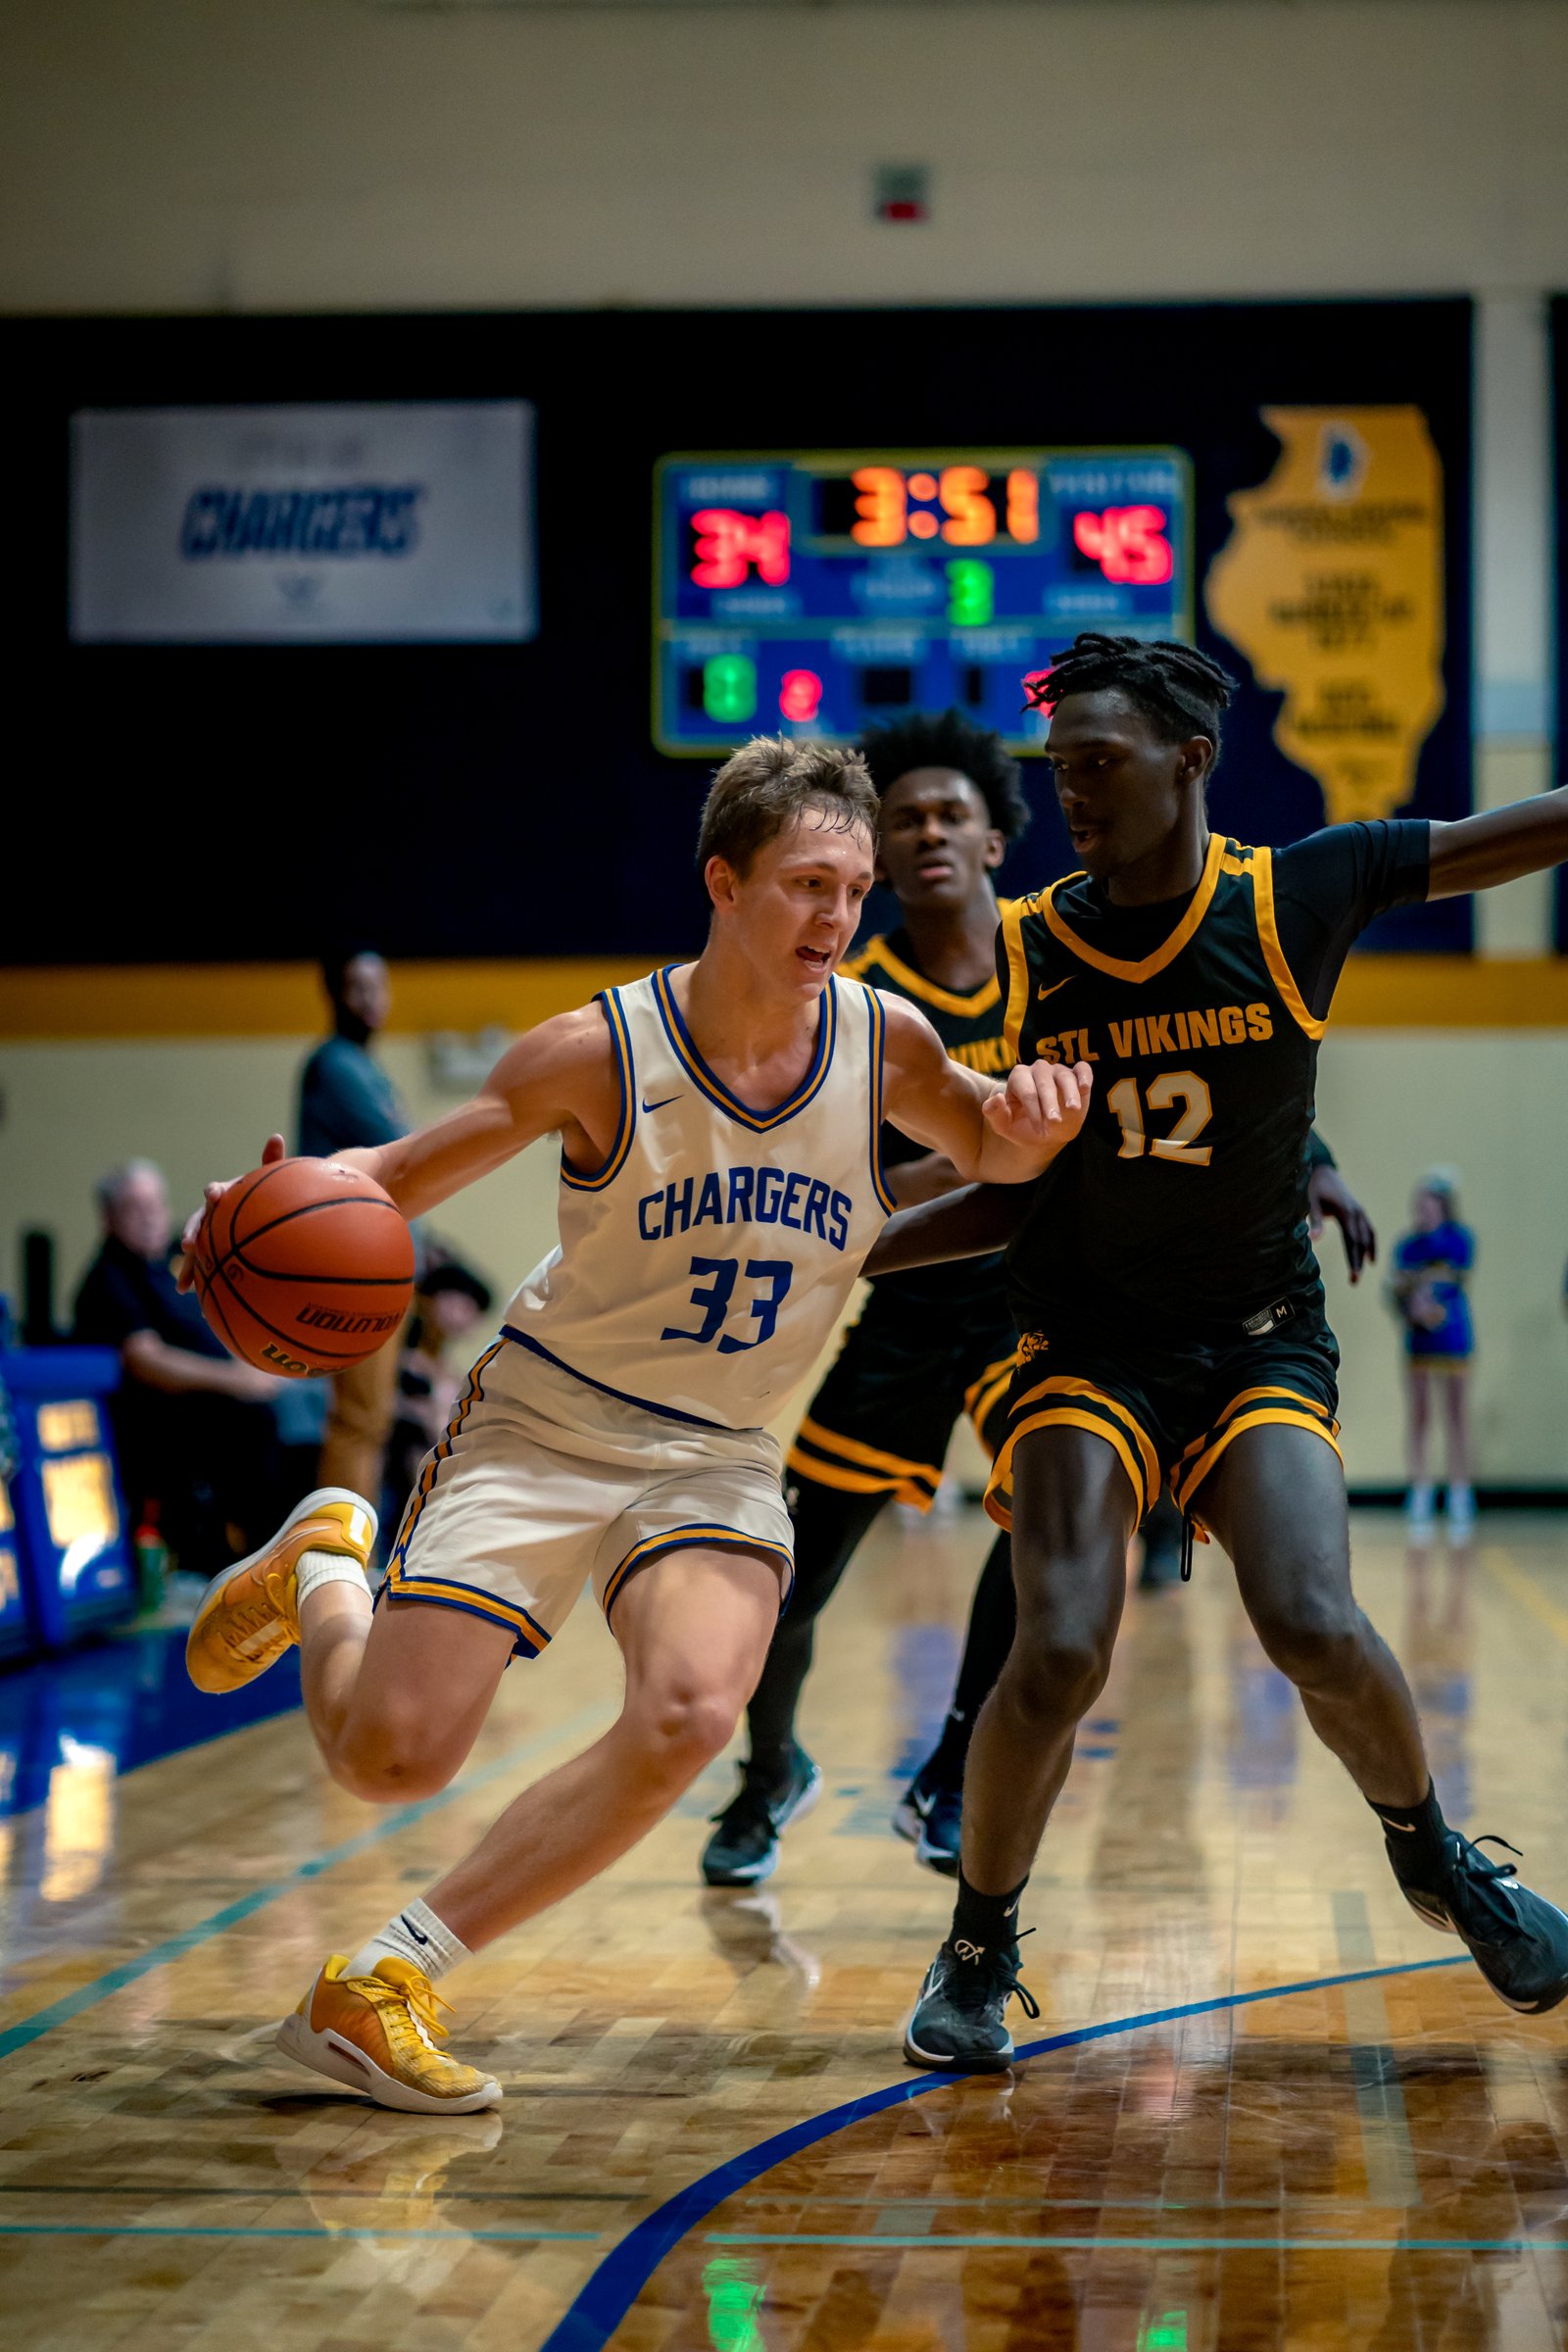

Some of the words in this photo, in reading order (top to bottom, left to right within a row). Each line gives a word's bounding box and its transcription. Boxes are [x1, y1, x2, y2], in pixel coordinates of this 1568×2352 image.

[851, 466, 1039, 547] 3:51
[689, 508, 791, 589] 34
[944, 557, 995, 627] 3
[1036, 1028, 1100, 1065] STL
[1108, 1003, 1274, 1058] VIKINGS
[1106, 1070, 1213, 1166] 12
[638, 1166, 853, 1251] CHARGERS
[661, 1255, 794, 1354] 33
[1276, 1305, 1288, 1318] M
